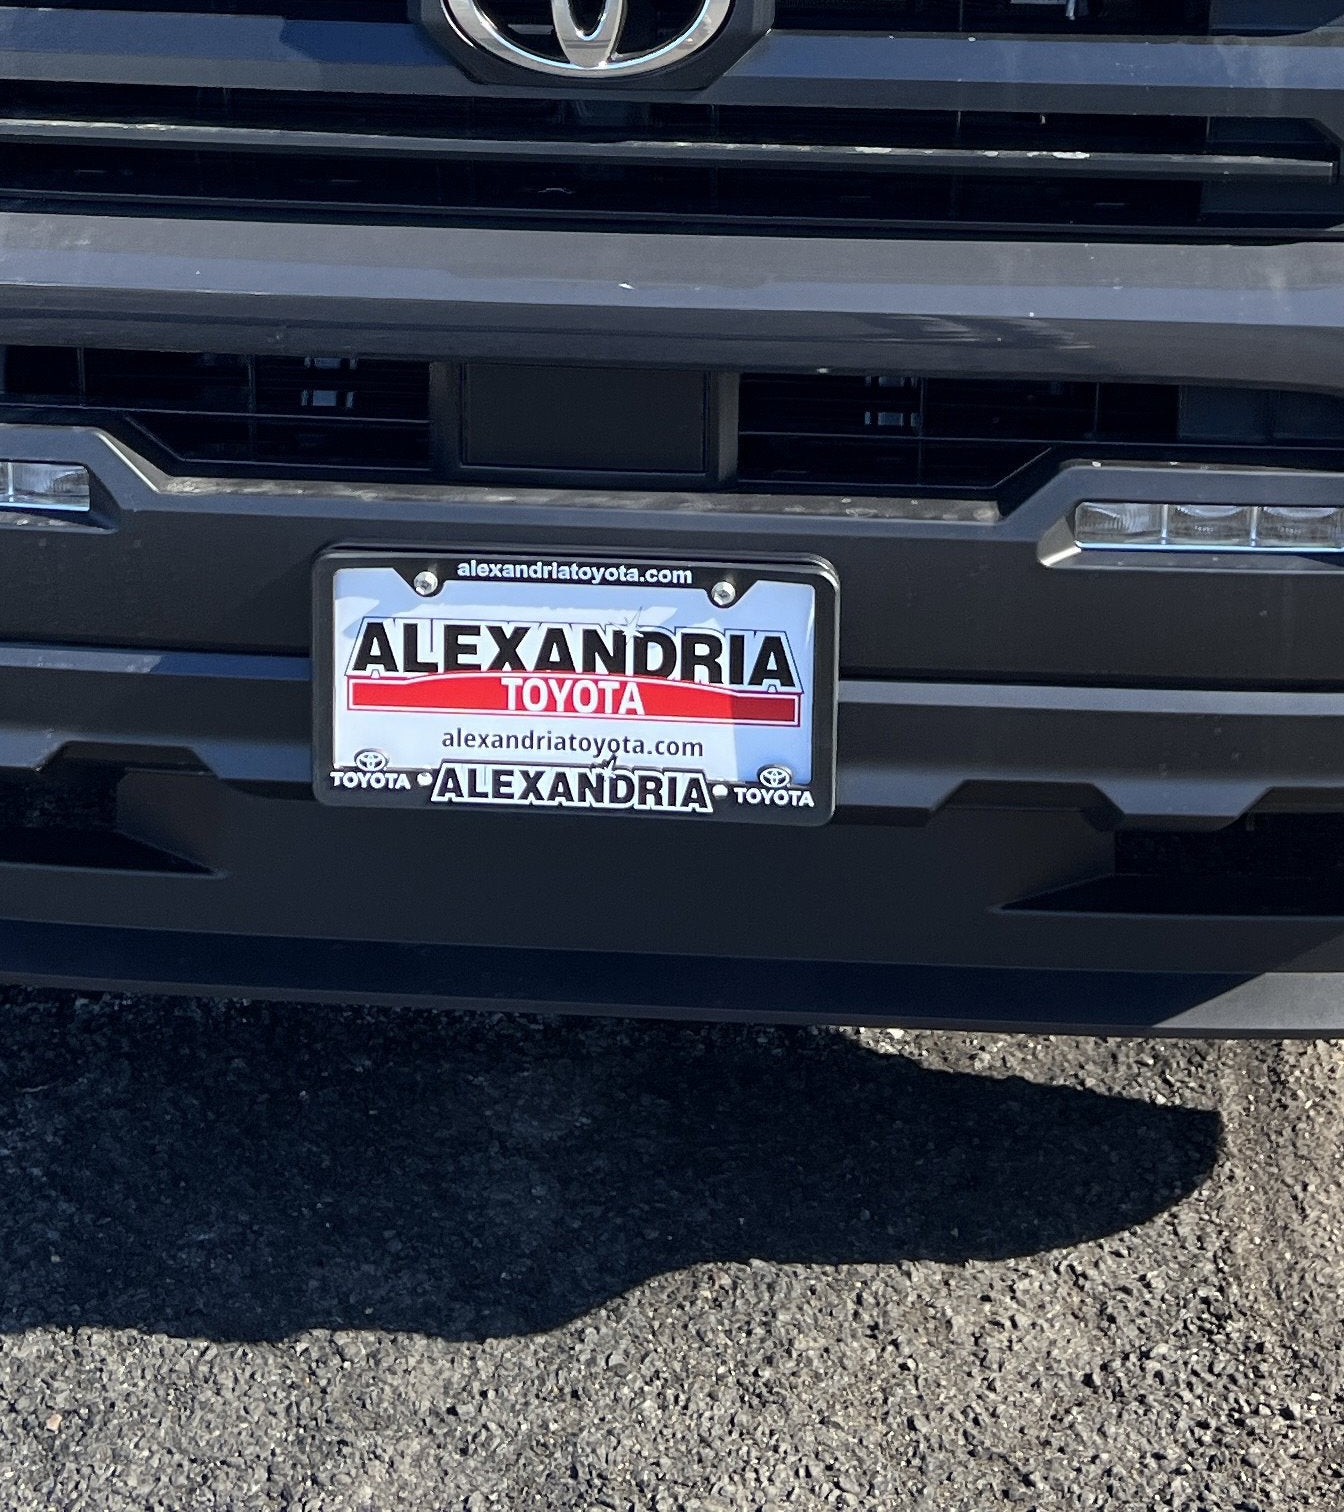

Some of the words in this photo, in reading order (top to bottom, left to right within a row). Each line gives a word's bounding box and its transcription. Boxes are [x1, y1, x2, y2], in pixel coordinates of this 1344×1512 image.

[457, 559, 693, 585] alexandriatoyota.com
[351, 621, 798, 688] ALEXANDRIA
[501, 676, 646, 716] TOYOTA
[442, 729, 704, 757] alexandriatoyota.com
[330, 771, 411, 791] TOYOTA
[434, 765, 711, 811] ALEXANDRIA
[733, 786, 814, 807] TOYOTA
